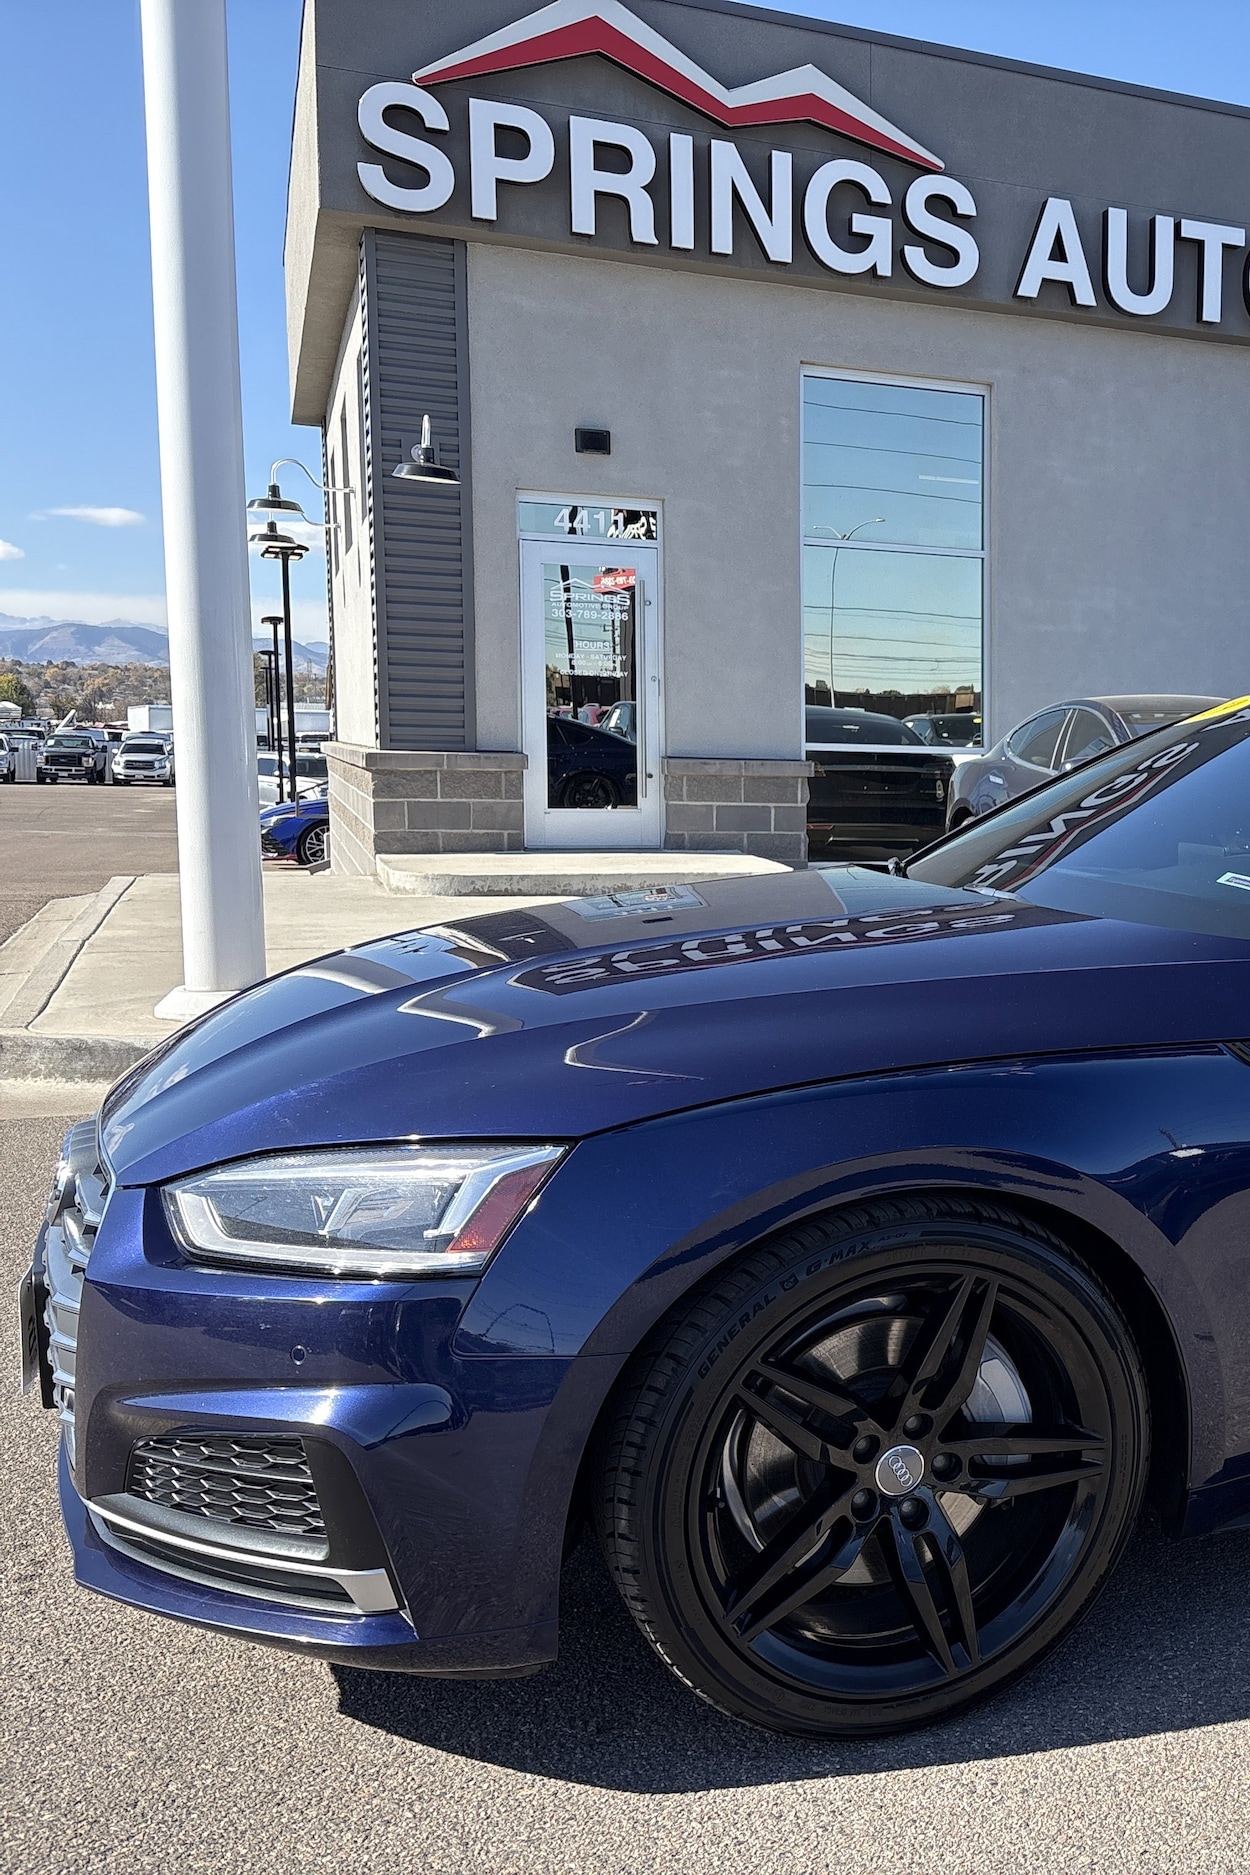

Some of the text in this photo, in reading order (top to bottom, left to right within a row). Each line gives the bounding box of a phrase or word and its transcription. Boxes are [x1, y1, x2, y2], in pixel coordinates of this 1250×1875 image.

[356, 81, 981, 288] SPRINGS
[550, 590, 631, 606] SPRINGS
[551, 601, 629, 611] AUTOMOTIVE GROUP
[551, 608, 629, 621] 303-789-2886
[575, 640, 610, 650] HOURS
[697, 1293, 777, 1379] GENERAL
